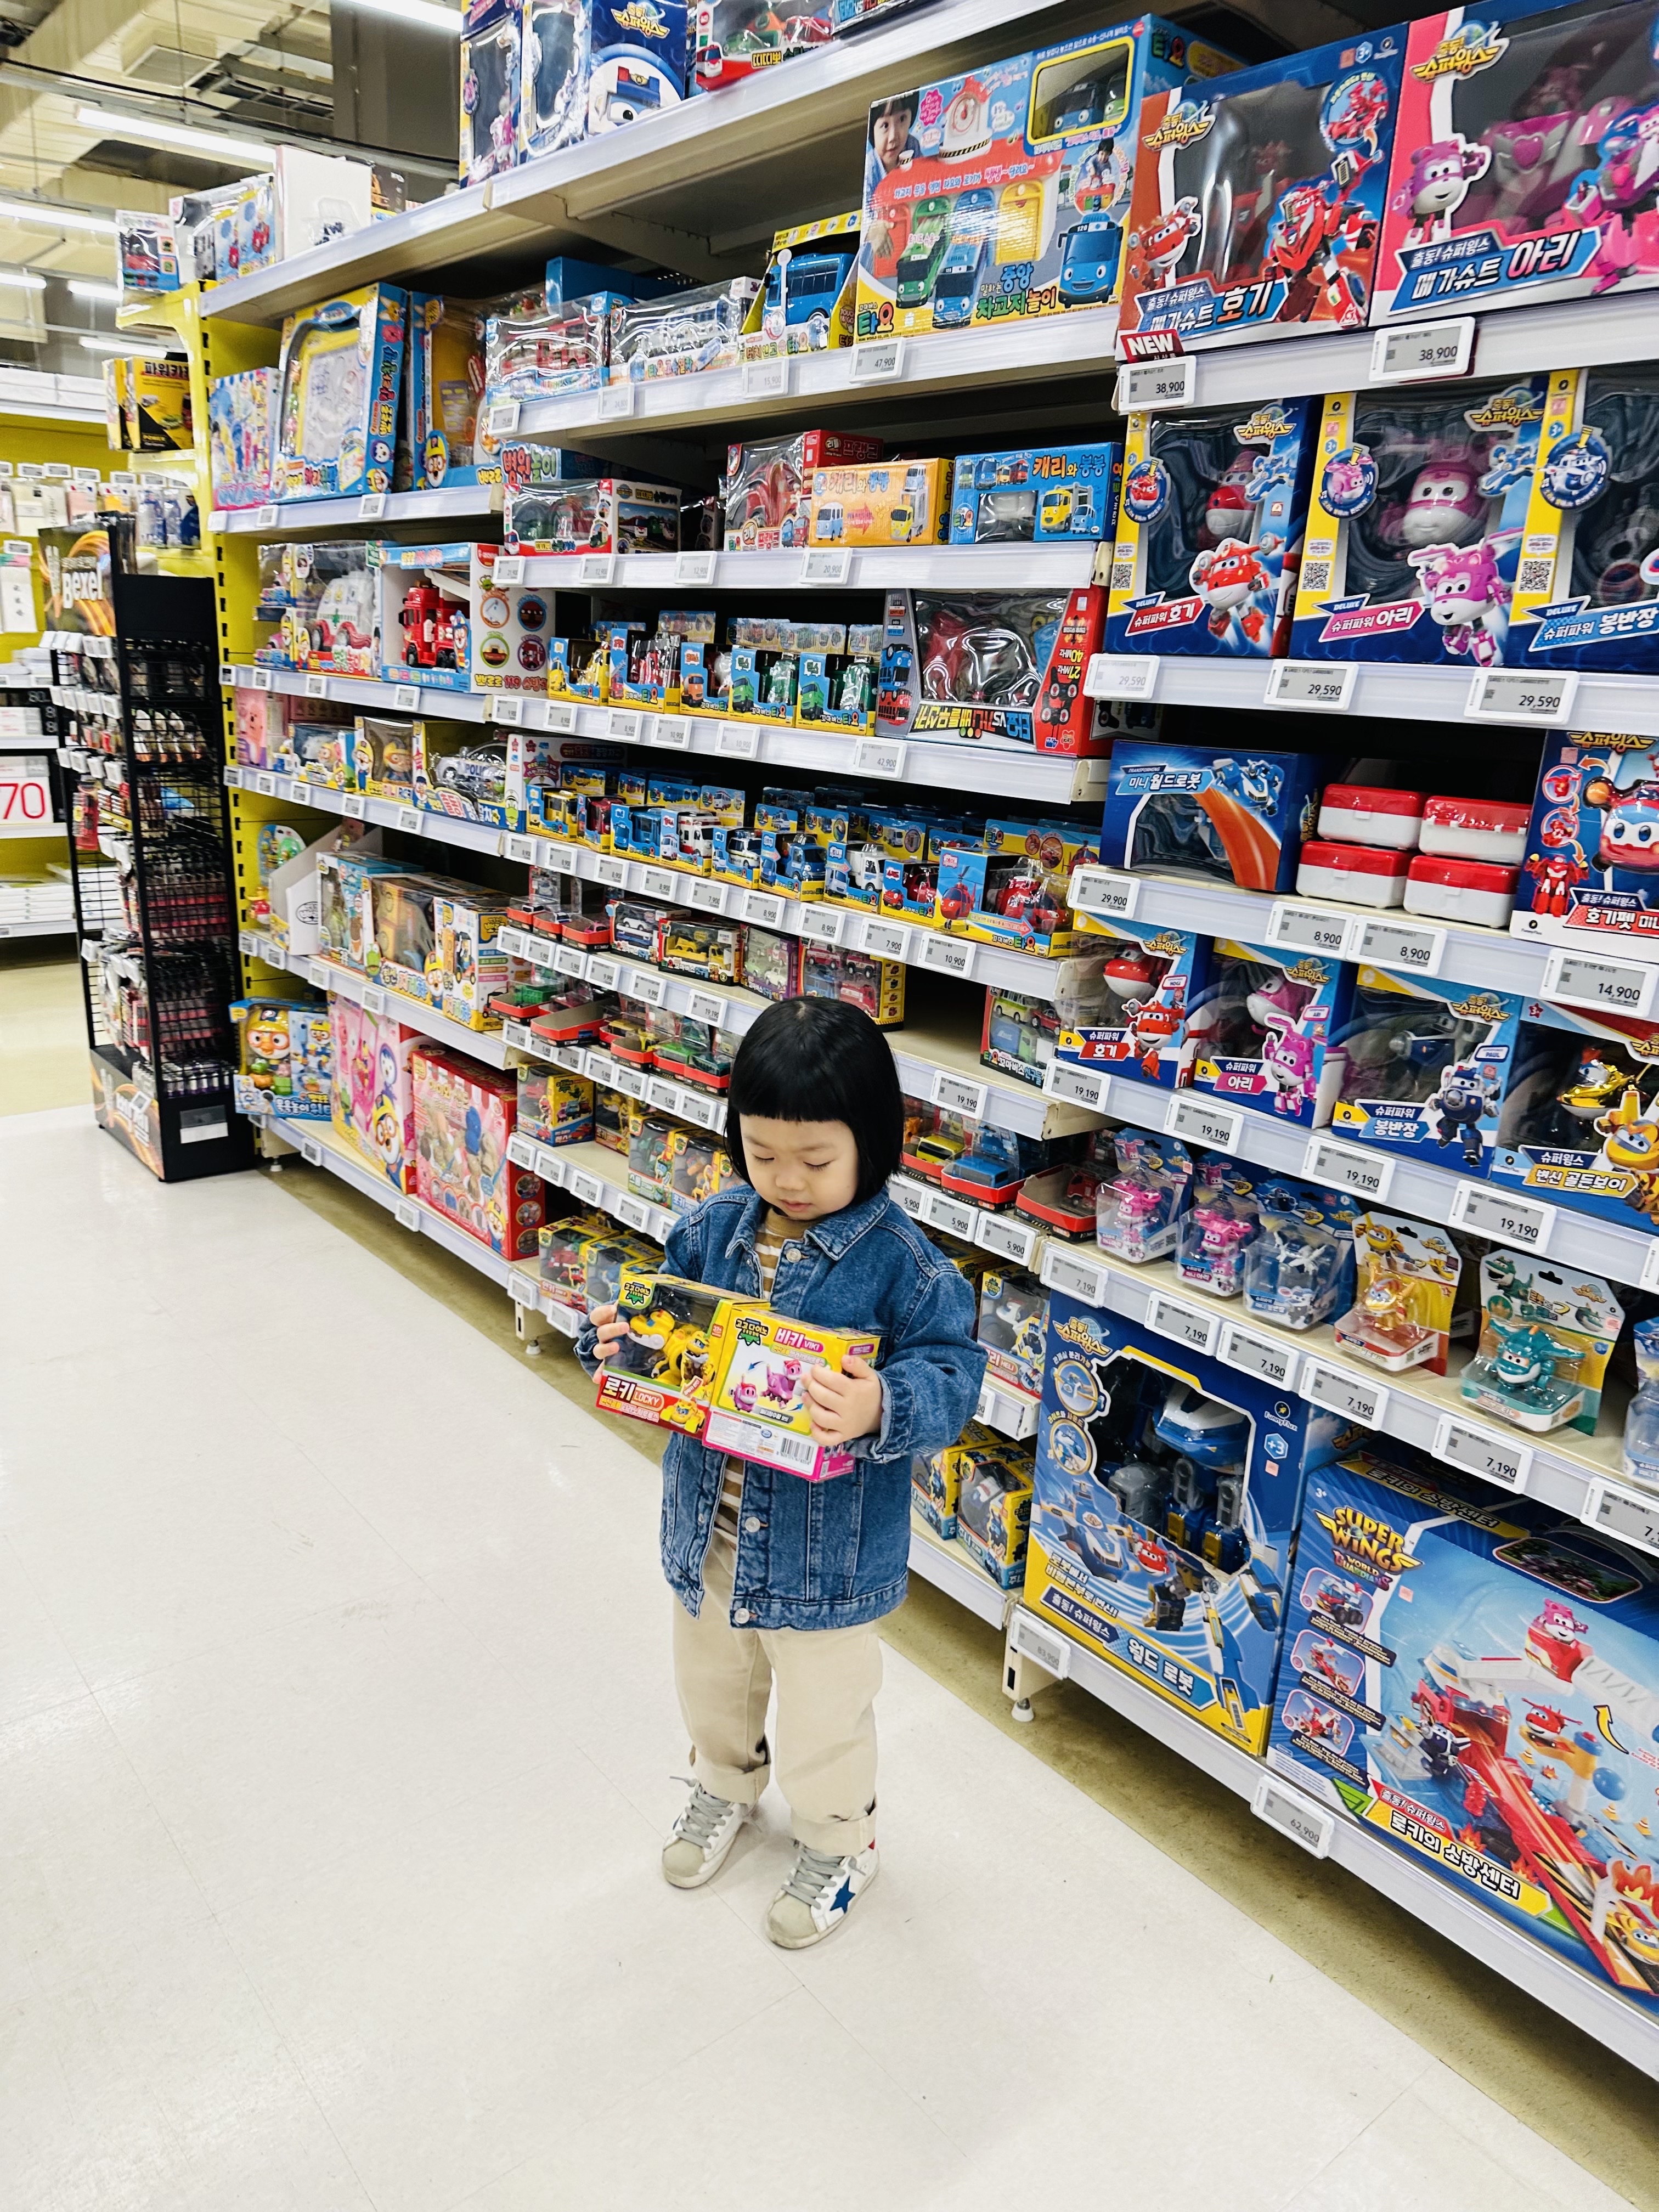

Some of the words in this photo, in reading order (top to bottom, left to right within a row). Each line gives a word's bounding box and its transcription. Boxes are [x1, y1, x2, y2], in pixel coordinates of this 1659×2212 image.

[613, 9, 669, 38] 슈퍼윙스
[1413, 43, 1504, 81] 슈퍼윙스
[1142, 120, 1210, 150] 슈퍼윙스
[1410, 250, 1439, 269] 출동!
[1441, 238, 1491, 261] 슈퍼윙스
[1412, 257, 1502, 300] 메가슈트
[1508, 231, 1582, 279] 아리
[980, 283, 1002, 296] 말하는
[1001, 262, 1034, 292] 중앙
[858, 302, 878, 312] 꼬마버스
[1147, 293, 1169, 311] 출동!
[1169, 286, 1206, 306] 슈퍼윙스
[1150, 303, 1214, 331] 메가슈트
[1216, 280, 1272, 323] 호기
[857, 301, 894, 336] 타요
[1126, 333, 1173, 356] NEW
[874, 357, 895, 368] 47,900
[1419, 346, 1458, 362] 38,900
[1155, 381, 1185, 394] 38,900
[1476, 407, 1539, 427] 슈퍼윙스
[1239, 422, 1293, 440] 슈퍼윙스
[843, 439, 879, 460] 프랭크
[502, 447, 557, 484] 병원놀이
[1032, 455, 1077, 479] 캐리와
[1079, 454, 1106, 478] 봉봉
[868, 470, 890, 493] 봉봉
[61, 567, 104, 608] Bexel
[1136, 598, 1158, 607] DELUXE
[1333, 600, 1360, 611] DELUXE
[1547, 604, 1577, 616] DELUXE
[1135, 612, 1167, 628] 슈퍼파워
[1167, 602, 1195, 624] 호기
[1331, 616, 1375, 633] 슈퍼파워
[1376, 605, 1414, 627] 아리
[1543, 621, 1595, 641] 슈퍼파워
[1598, 606, 1658, 636] 봉반장
[1057, 664, 1081, 679] 27MHz
[1119, 675, 1146, 686] 29,590
[641, 687, 658, 704] 타요
[1308, 684, 1342, 697] 29,590
[1519, 695, 1560, 708] 29,590
[752, 707, 771, 716] 꼬마버스
[771, 704, 786, 719] 타요
[821, 713, 842, 724] 꼬마버스
[842, 711, 860, 726] 타요
[1576, 731, 1651, 753] 슈퍼윙스
[877, 758, 897, 768] 42,900
[1129, 777, 1149, 789] 미니
[1149, 773, 1201, 791] 월드로봇
[1101, 894, 1127, 907] 29,900
[1582, 893, 1602, 904] 출동!
[1602, 894, 1637, 907] 슈퍼윙스
[1585, 907, 1636, 930] 호기펫
[886, 940, 901, 951] 7,900
[992, 933, 1013, 945] 꼬마버스
[1013, 935, 1036, 953] 타요
[1314, 931, 1342, 945] 8,900
[1146, 940, 1187, 956] 슈퍼윙스
[1400, 946, 1430, 961] 8,900
[945, 953, 965, 966] 10,900
[1288, 967, 1331, 985] 슈퍼윙스
[1599, 983, 1640, 1000] 14,900
[1453, 1002, 1510, 1021] 슈퍼윙스
[1088, 1031, 1120, 1042] 슈퍼파워
[1093, 1043, 1116, 1059] 호기
[983, 1050, 999, 1065] 타요
[998, 1054, 1024, 1076] 꼬마버스
[1224, 1062, 1256, 1073] 슈퍼파워
[1075, 1086, 1099, 1100] 19,190
[1228, 1076, 1253, 1092] 아리
[956, 1094, 977, 1108] 19,190
[1375, 1106, 1416, 1118] 슈퍼파워
[1202, 1124, 1229, 1140] 19,190
[1374, 1119, 1419, 1138] 봉반장
[1541, 1153, 1584, 1166] 슈퍼윙스
[1346, 1169, 1380, 1188] 19,190
[1536, 1170, 1561, 1186] 변신
[1564, 1173, 1628, 1191] 골든보이
[904, 1197, 919, 1209] 5,900
[951, 1218, 968, 1231] 5,900
[1500, 1218, 1539, 1238] 19,190
[1007, 1241, 1025, 1255] 5,900
[624, 1282, 651, 1299] 고고다이노
[1076, 1279, 1096, 1293] 7,190
[735, 1318, 769, 1336] 고고다이노
[1184, 1325, 1207, 1341] 7,190
[774, 1328, 804, 1348] 비키
[804, 1340, 821, 1351] VIKI
[1054, 1319, 1112, 1357] 슈퍼윙스
[1261, 1359, 1285, 1376] 7,190
[602, 1376, 637, 1402] 로키
[634, 1390, 661, 1408] LOCKY
[1347, 1396, 1375, 1415] 7,190
[1265, 1410, 1298, 1432] FunnyFlux
[1486, 1457, 1517, 1478] 7,190
[1316, 1488, 1327, 1498] 3+
[1366, 1468, 1420, 1496] 로키의
[1420, 1490, 1500, 1528] 소방센터
[1333, 1505, 1406, 1554] SUPER
[1330, 1524, 1409, 1575] WINGS
[1333, 1550, 1393, 1592] GUARDIANS
[1347, 1554, 1380, 1577] WORLD
[1052, 1592, 1073, 1614] 출동!
[1074, 1605, 1111, 1638] 슈퍼윙스
[1127, 1637, 1159, 1672] 월드
[1163, 1661, 1195, 1696] 로봇
[1381, 1787, 1406, 1810] 출동!
[1404, 1799, 1447, 1831] 슈퍼윙스
[1290, 1818, 1321, 1843] 62,900
[1390, 1810, 1441, 1854] 로키의
[1443, 1842, 1521, 1901] 소방센터
